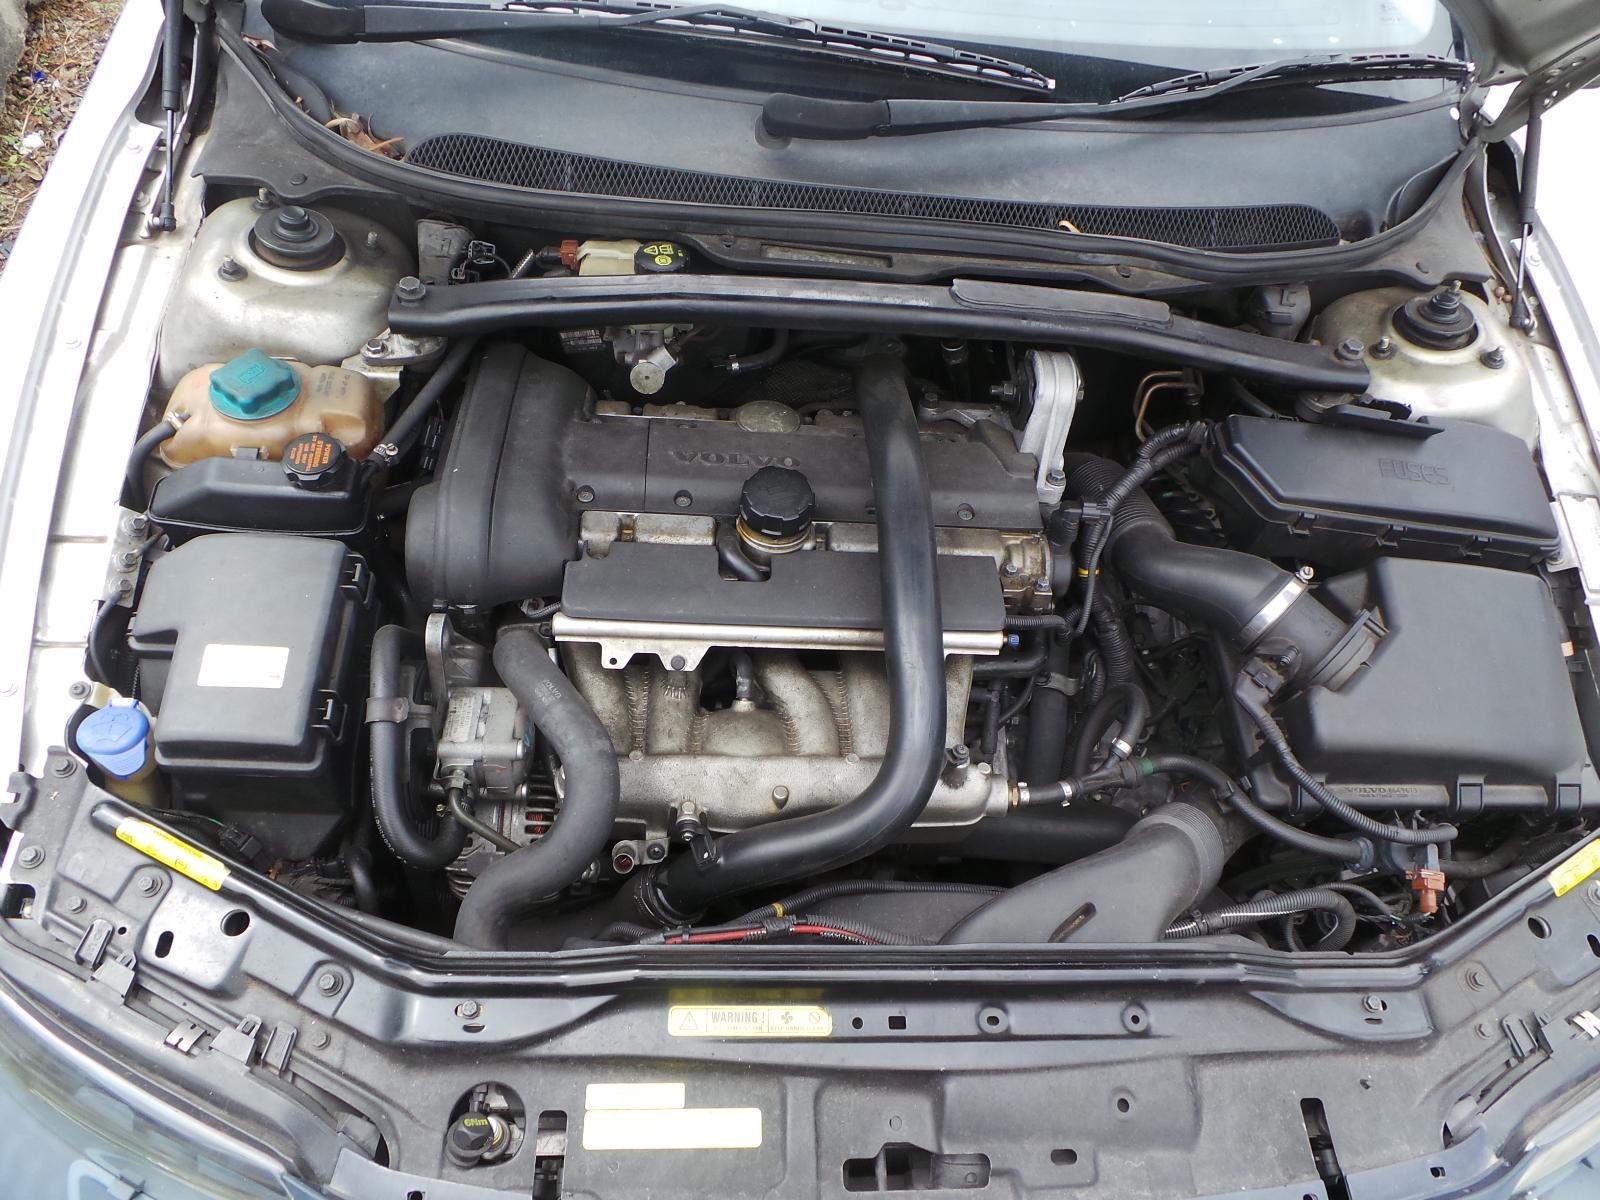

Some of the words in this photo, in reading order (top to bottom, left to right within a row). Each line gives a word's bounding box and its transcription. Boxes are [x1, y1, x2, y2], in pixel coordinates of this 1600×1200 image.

[312, 440, 324, 468] STEERING
[322, 443, 332, 464] POWER
[668, 450, 801, 470] VOLVO
[1377, 457, 1449, 485] FUSES
[711, 1011, 758, 1023] WARNING
[464, 1118, 488, 1127] 6Nm
